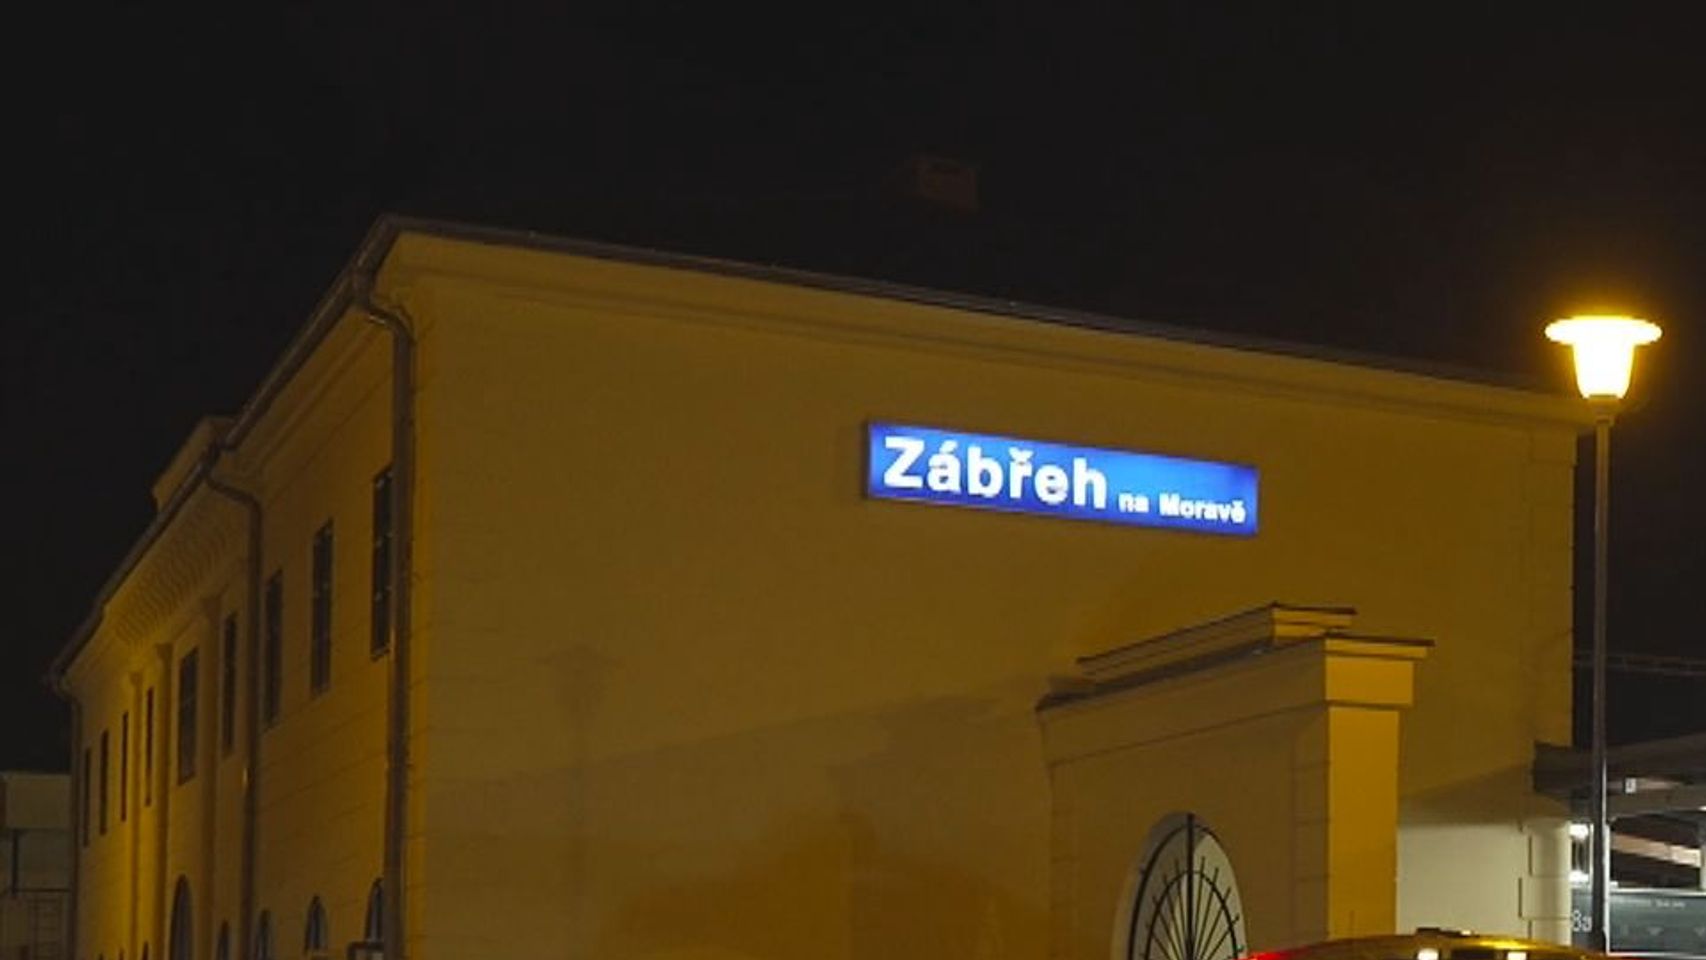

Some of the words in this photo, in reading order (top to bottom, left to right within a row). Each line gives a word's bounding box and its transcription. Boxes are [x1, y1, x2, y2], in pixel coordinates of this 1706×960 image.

[883, 436, 1107, 510] Zábřeh
[1118, 492, 1150, 513] na
[1159, 493, 1247, 524] Moravě
